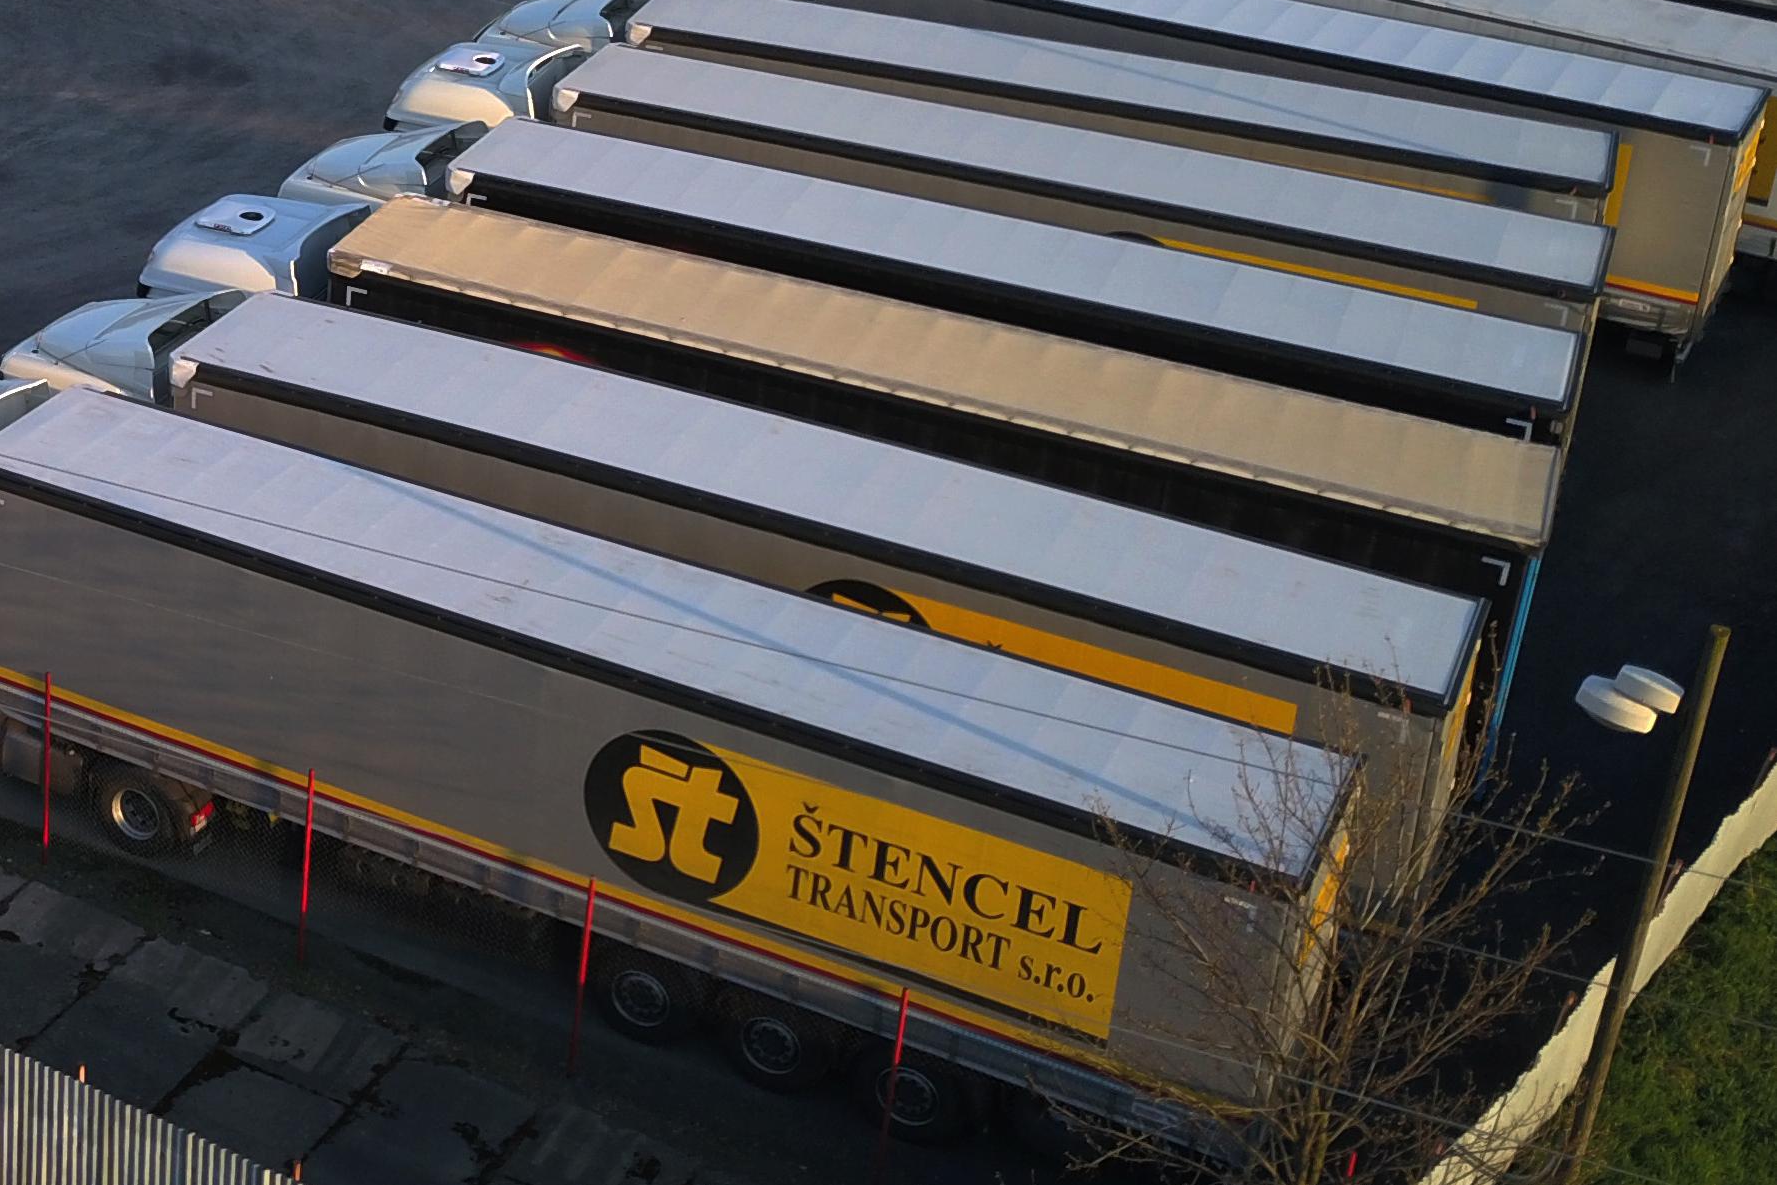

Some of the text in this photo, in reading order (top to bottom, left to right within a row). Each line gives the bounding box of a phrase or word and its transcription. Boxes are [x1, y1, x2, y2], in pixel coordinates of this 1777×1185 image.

[786, 864, 1095, 1003] TRANSPORT s.r.o.
[789, 801, 1103, 955] ŠTENCEL
